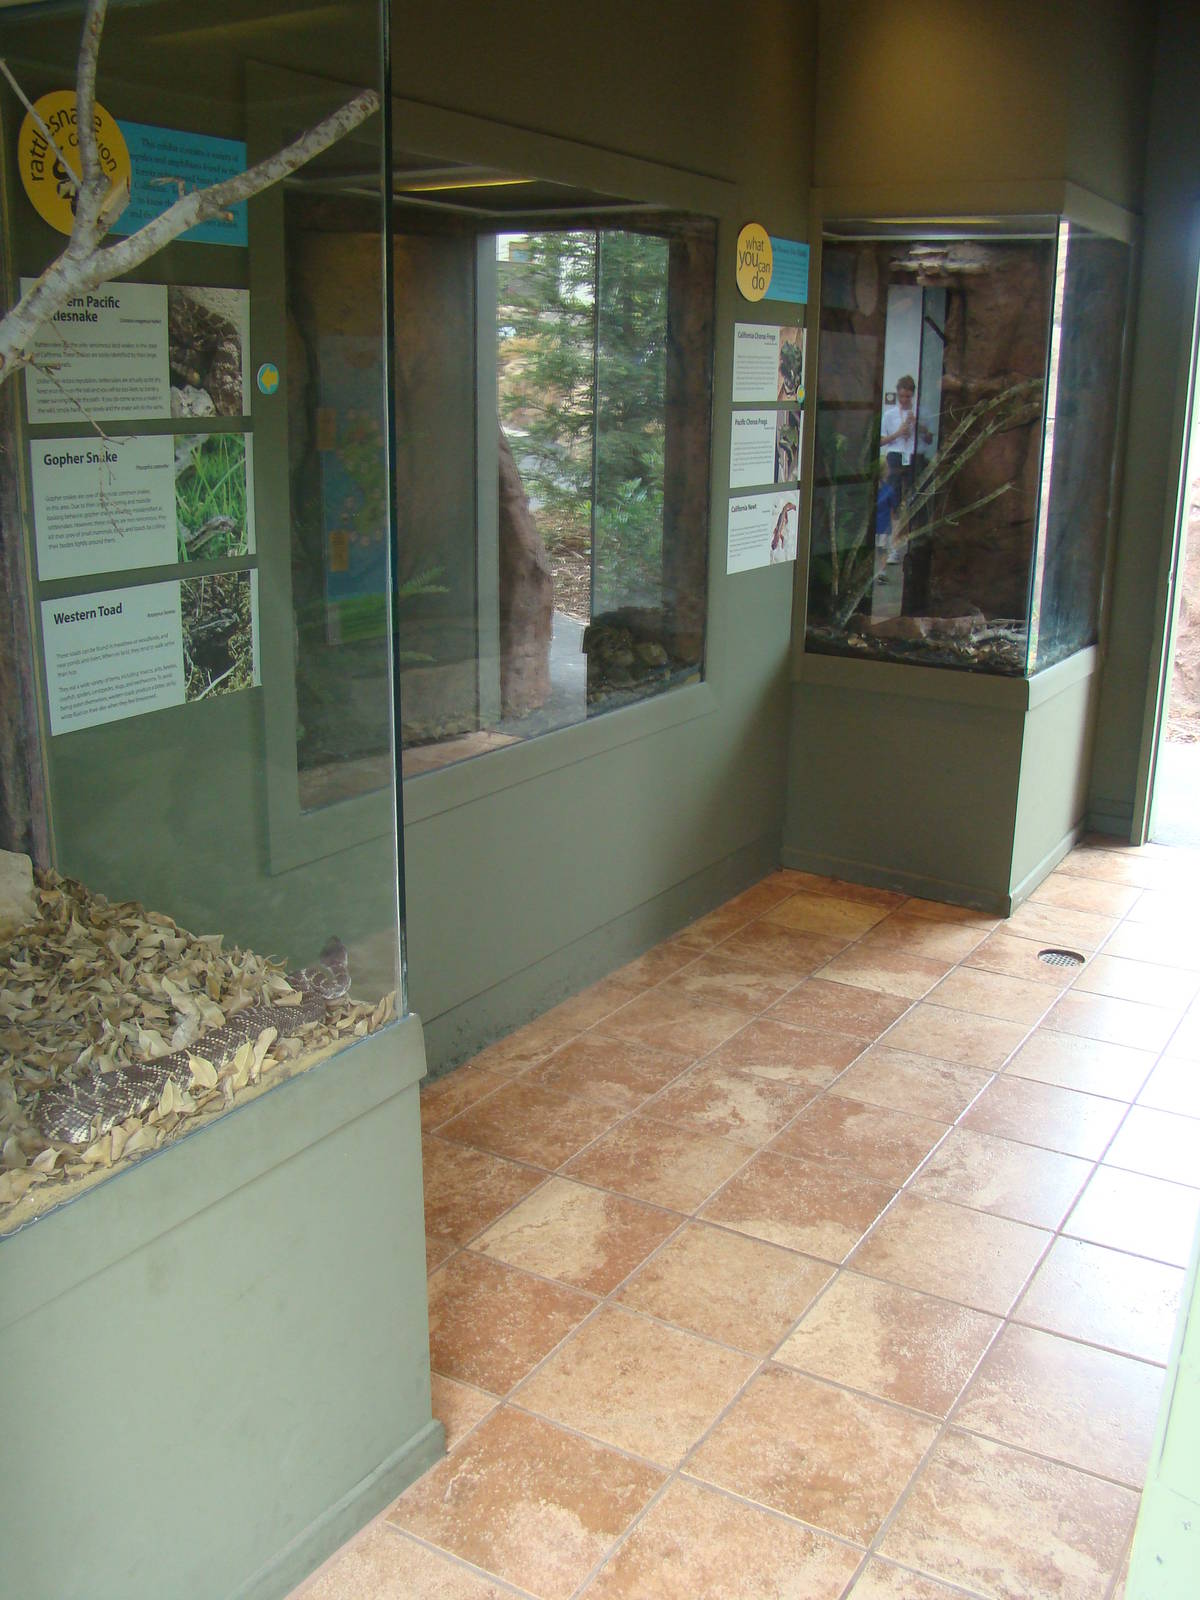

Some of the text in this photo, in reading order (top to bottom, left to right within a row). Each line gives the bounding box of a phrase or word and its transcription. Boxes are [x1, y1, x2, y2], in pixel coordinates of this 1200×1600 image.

[745, 235, 764, 252] what
[738, 249, 759, 271] you
[758, 262, 771, 273] can
[751, 271, 765, 290] do
[86, 295, 120, 309] Pacific
[43, 452, 84, 468] Gopher
[53, 602, 122, 625] Western Toad
